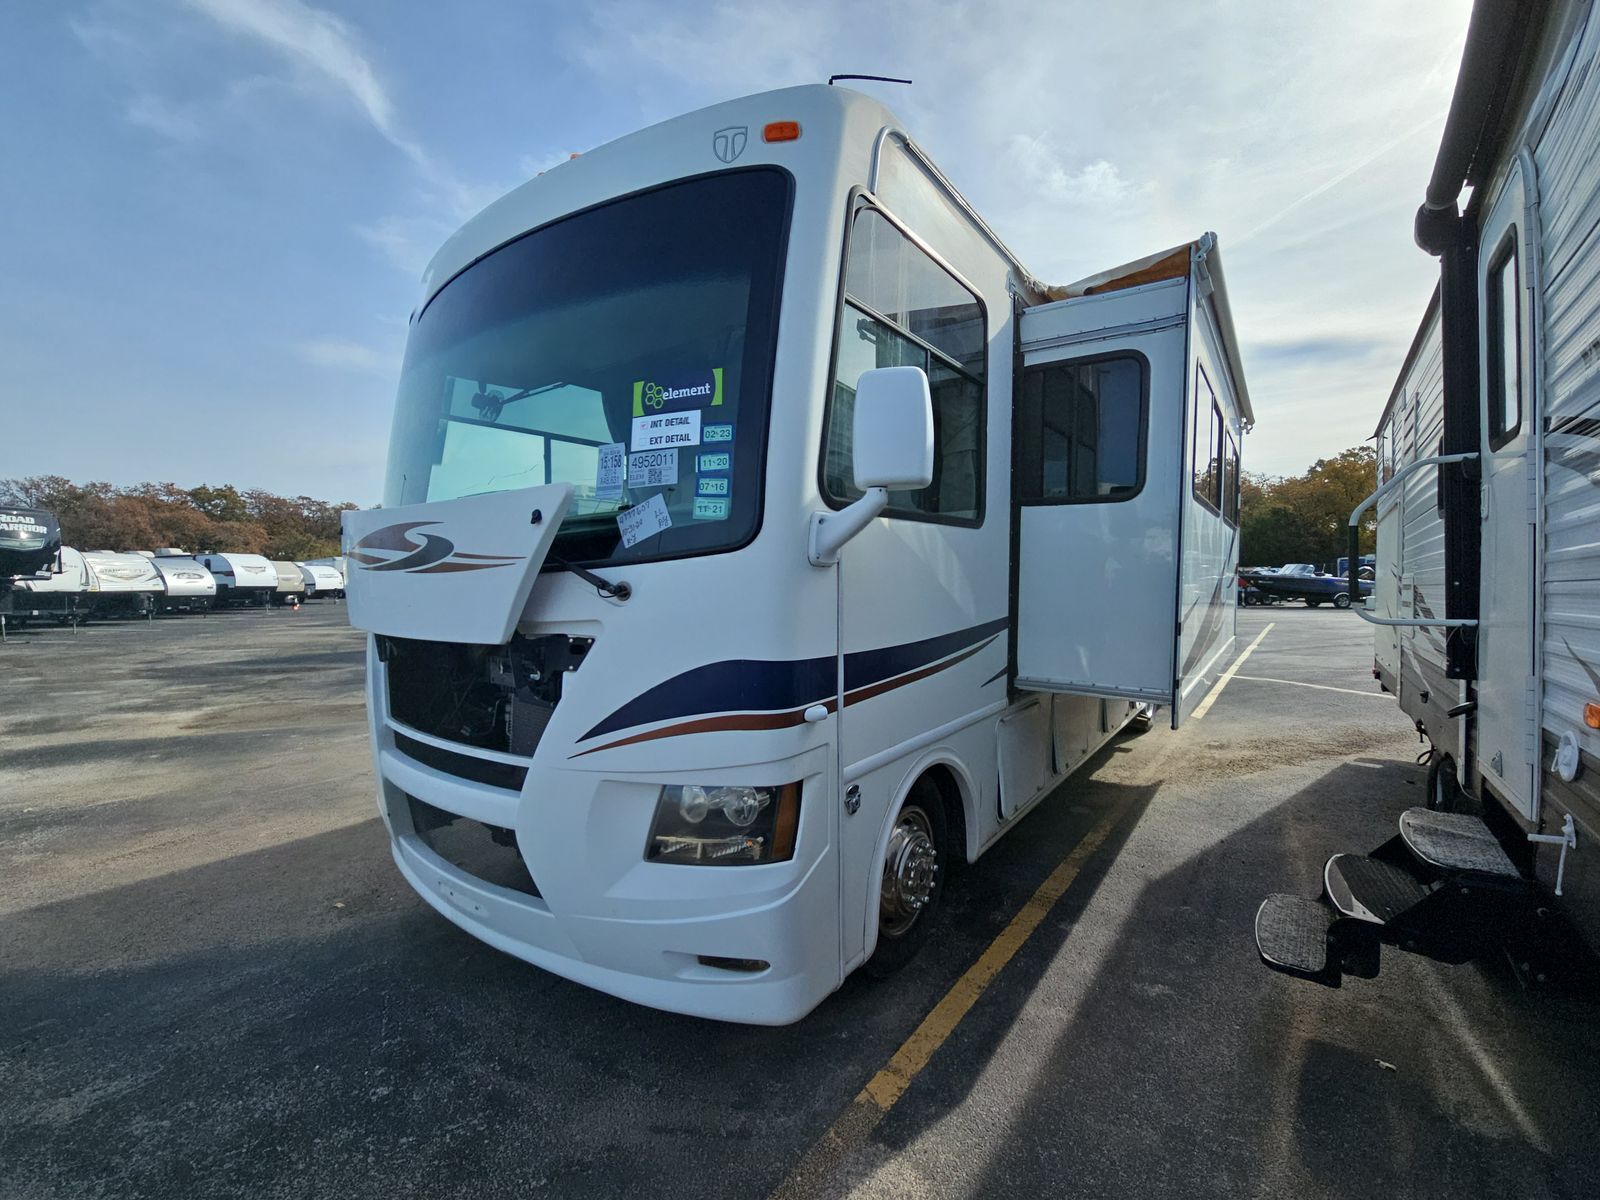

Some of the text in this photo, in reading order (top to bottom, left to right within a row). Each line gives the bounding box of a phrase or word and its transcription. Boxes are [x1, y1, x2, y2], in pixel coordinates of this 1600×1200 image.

[662, 382, 711, 400] element
[650, 416, 691, 429] INT DETAIL
[649, 433, 691, 446] EXT DETAIL
[631, 452, 674, 469] 4952011
[0, 523, 47, 534] ARRIOR
